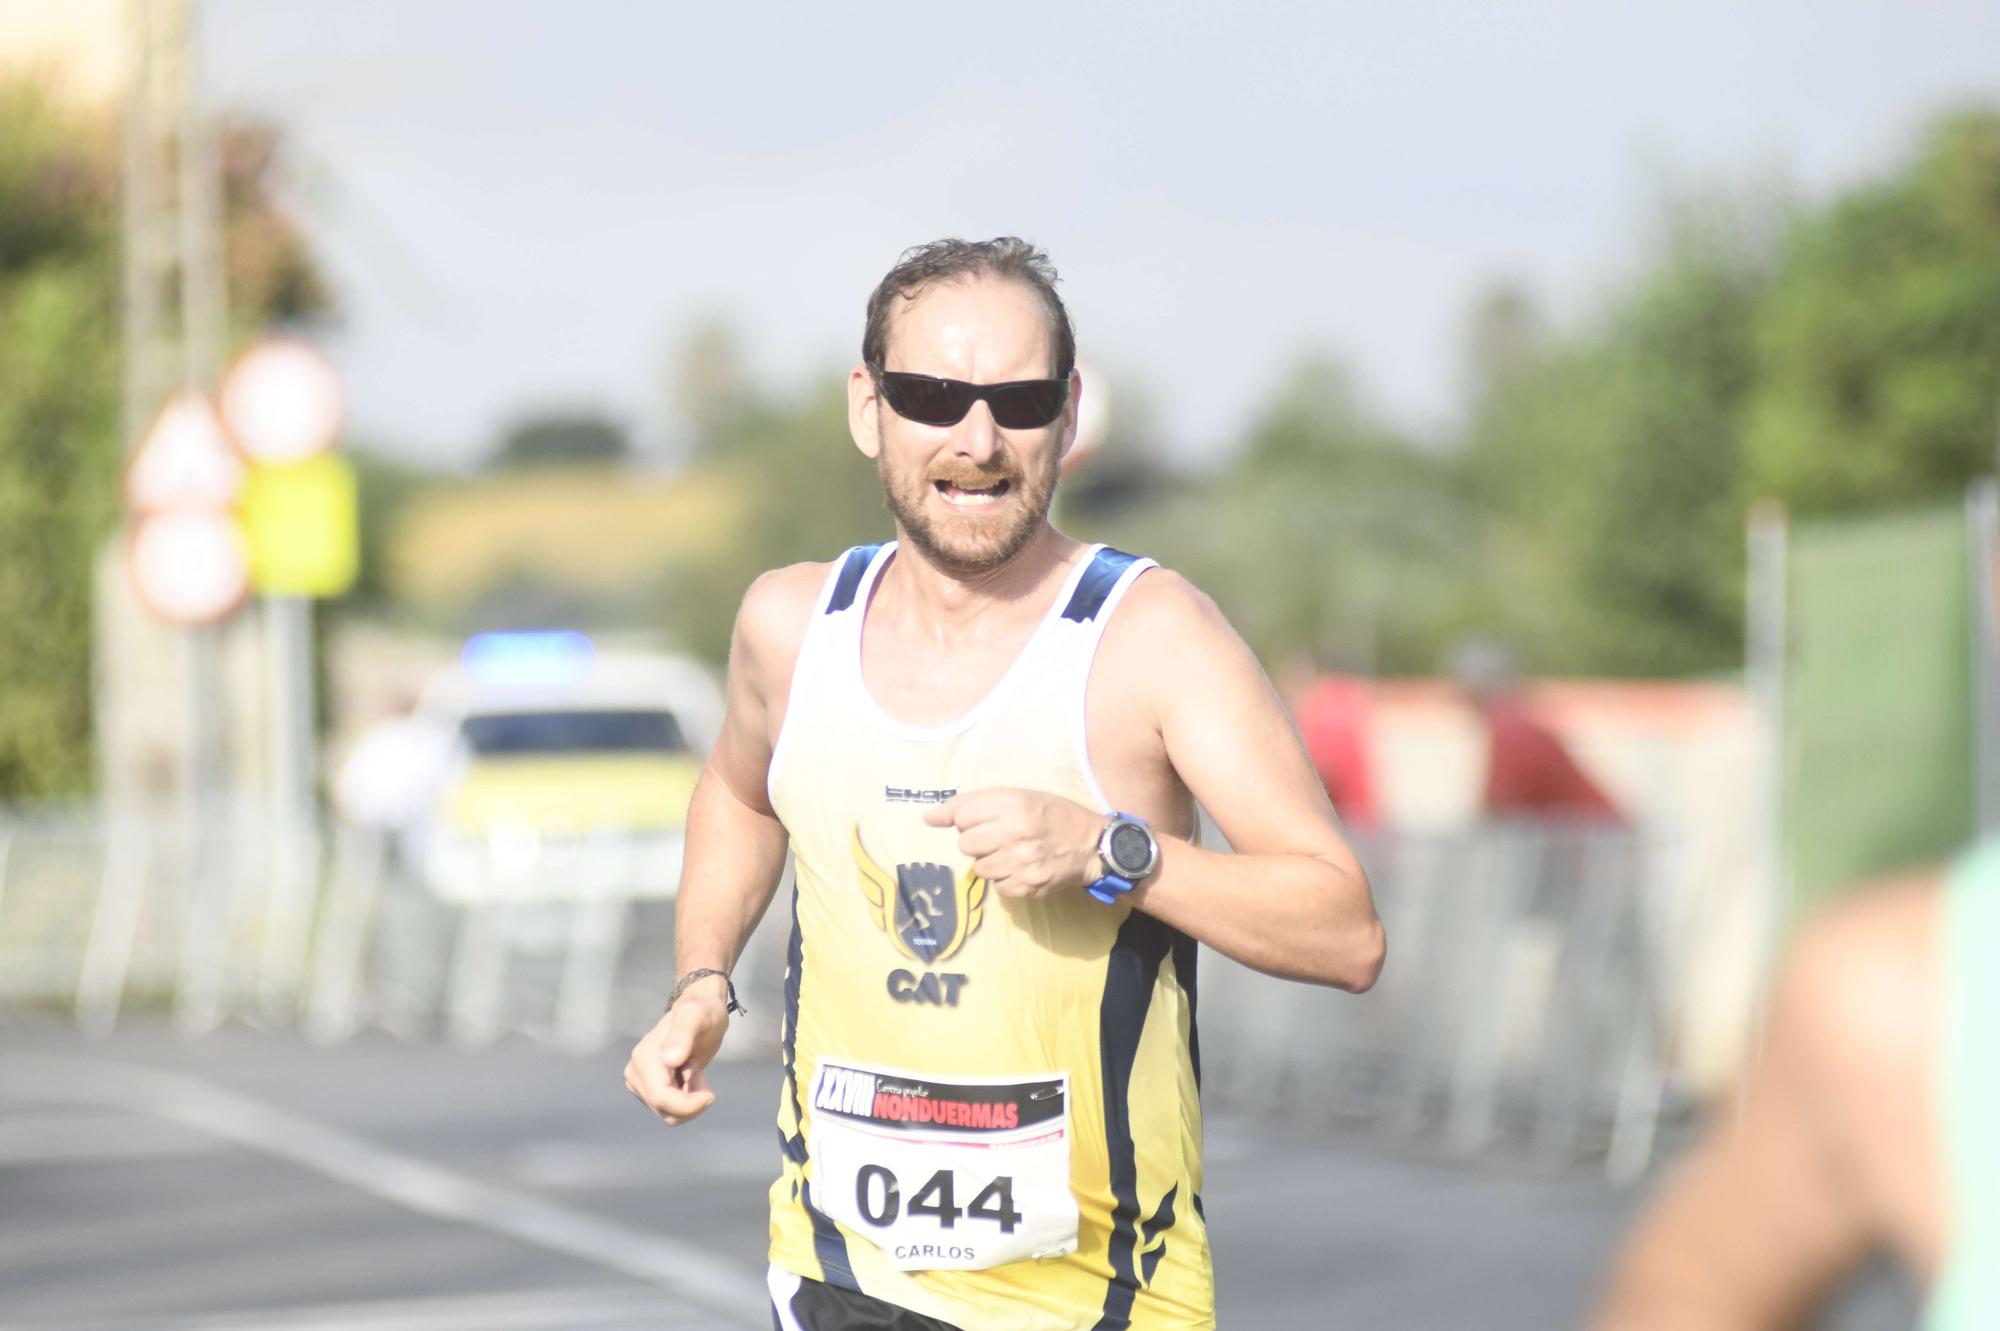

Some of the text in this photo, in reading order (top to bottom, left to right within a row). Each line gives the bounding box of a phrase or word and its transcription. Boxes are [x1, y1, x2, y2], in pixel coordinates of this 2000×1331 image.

[887, 968, 968, 1007] CAT
[873, 1093, 1018, 1129] NONDUERMAS
[856, 1163, 1022, 1234] 044
[895, 1244, 975, 1260] CARLOS
